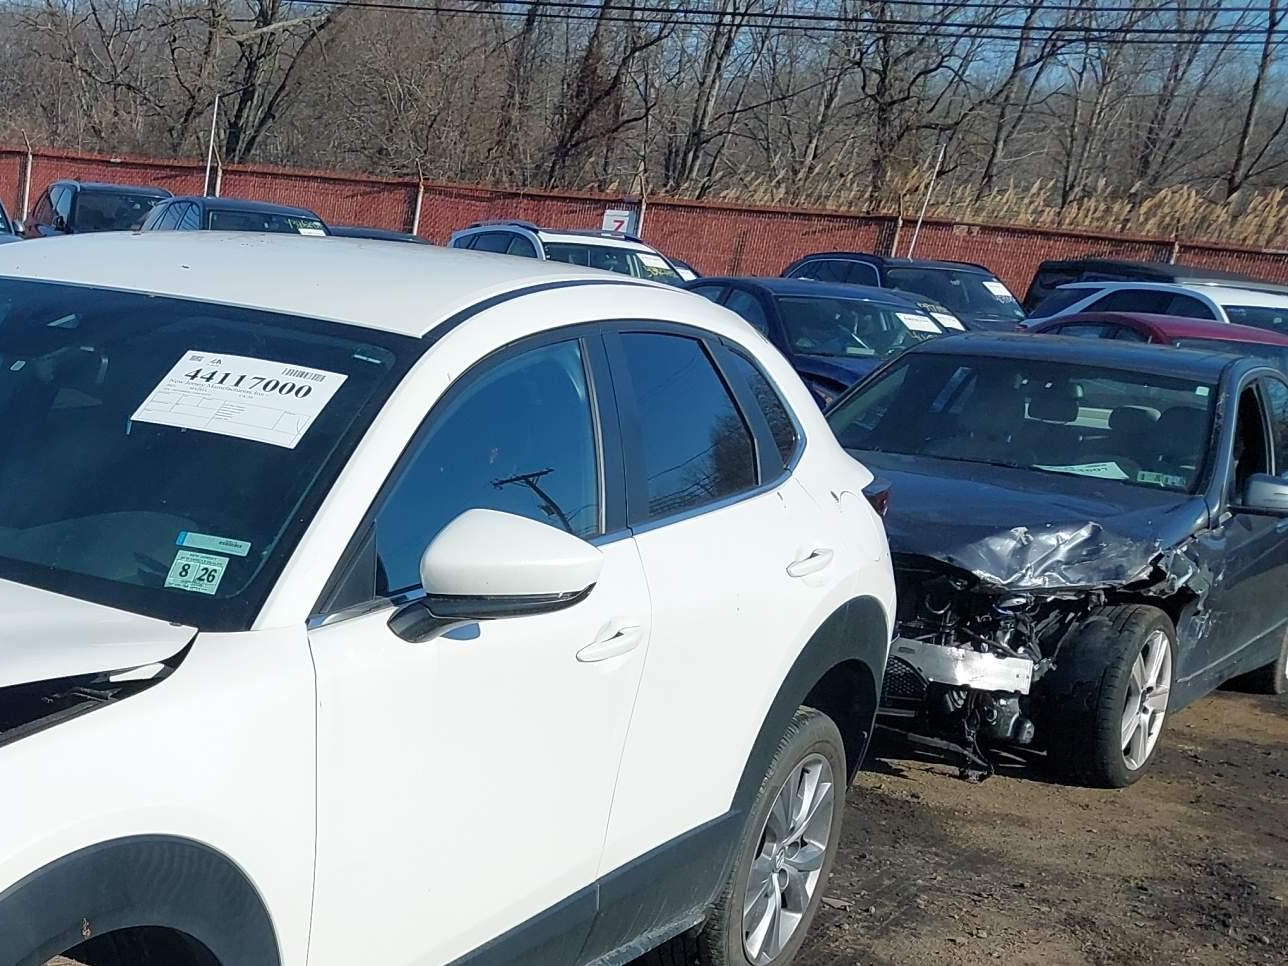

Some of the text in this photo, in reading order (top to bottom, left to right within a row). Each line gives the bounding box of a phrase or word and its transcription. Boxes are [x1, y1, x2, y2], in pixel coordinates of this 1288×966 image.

[613, 220, 625, 232] 7
[184, 367, 312, 399] 44117000
[179, 563, 218, 583] 8 26
